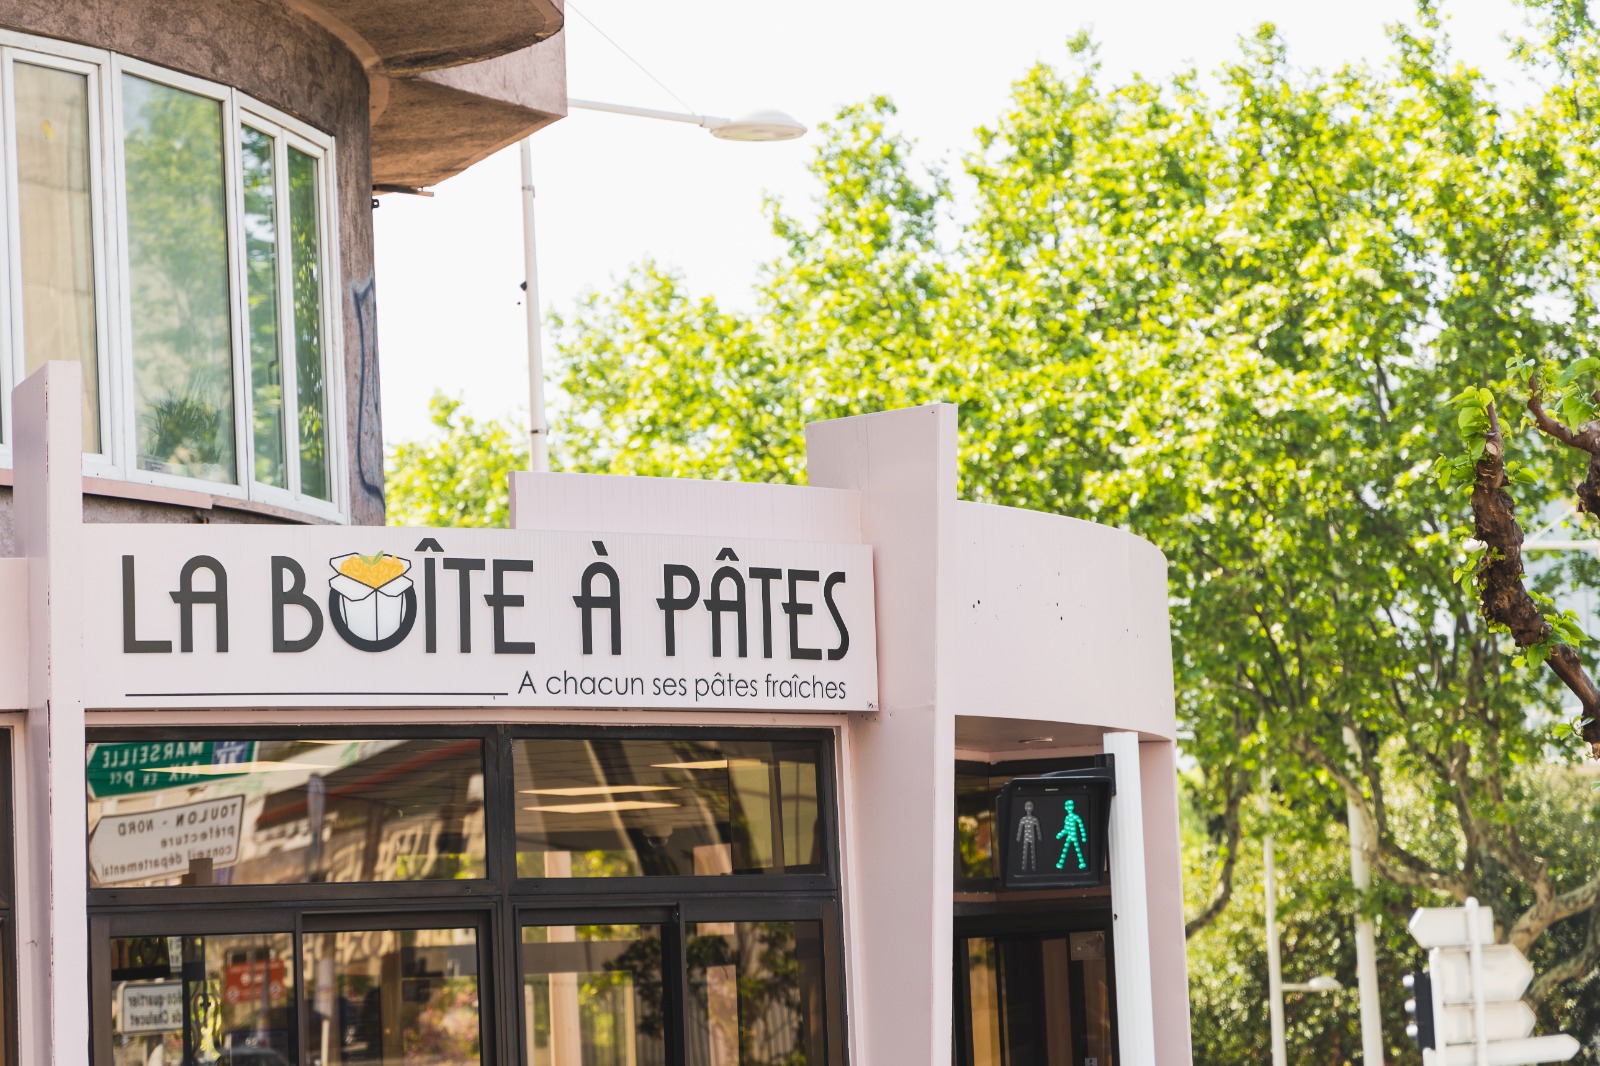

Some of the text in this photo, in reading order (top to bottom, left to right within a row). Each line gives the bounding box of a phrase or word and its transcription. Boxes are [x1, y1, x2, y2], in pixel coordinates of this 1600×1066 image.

[122, 538, 850, 660] LA BOÎTE À PÂTES
[517, 671, 847, 702] A chacun ses pâtes fraîches
